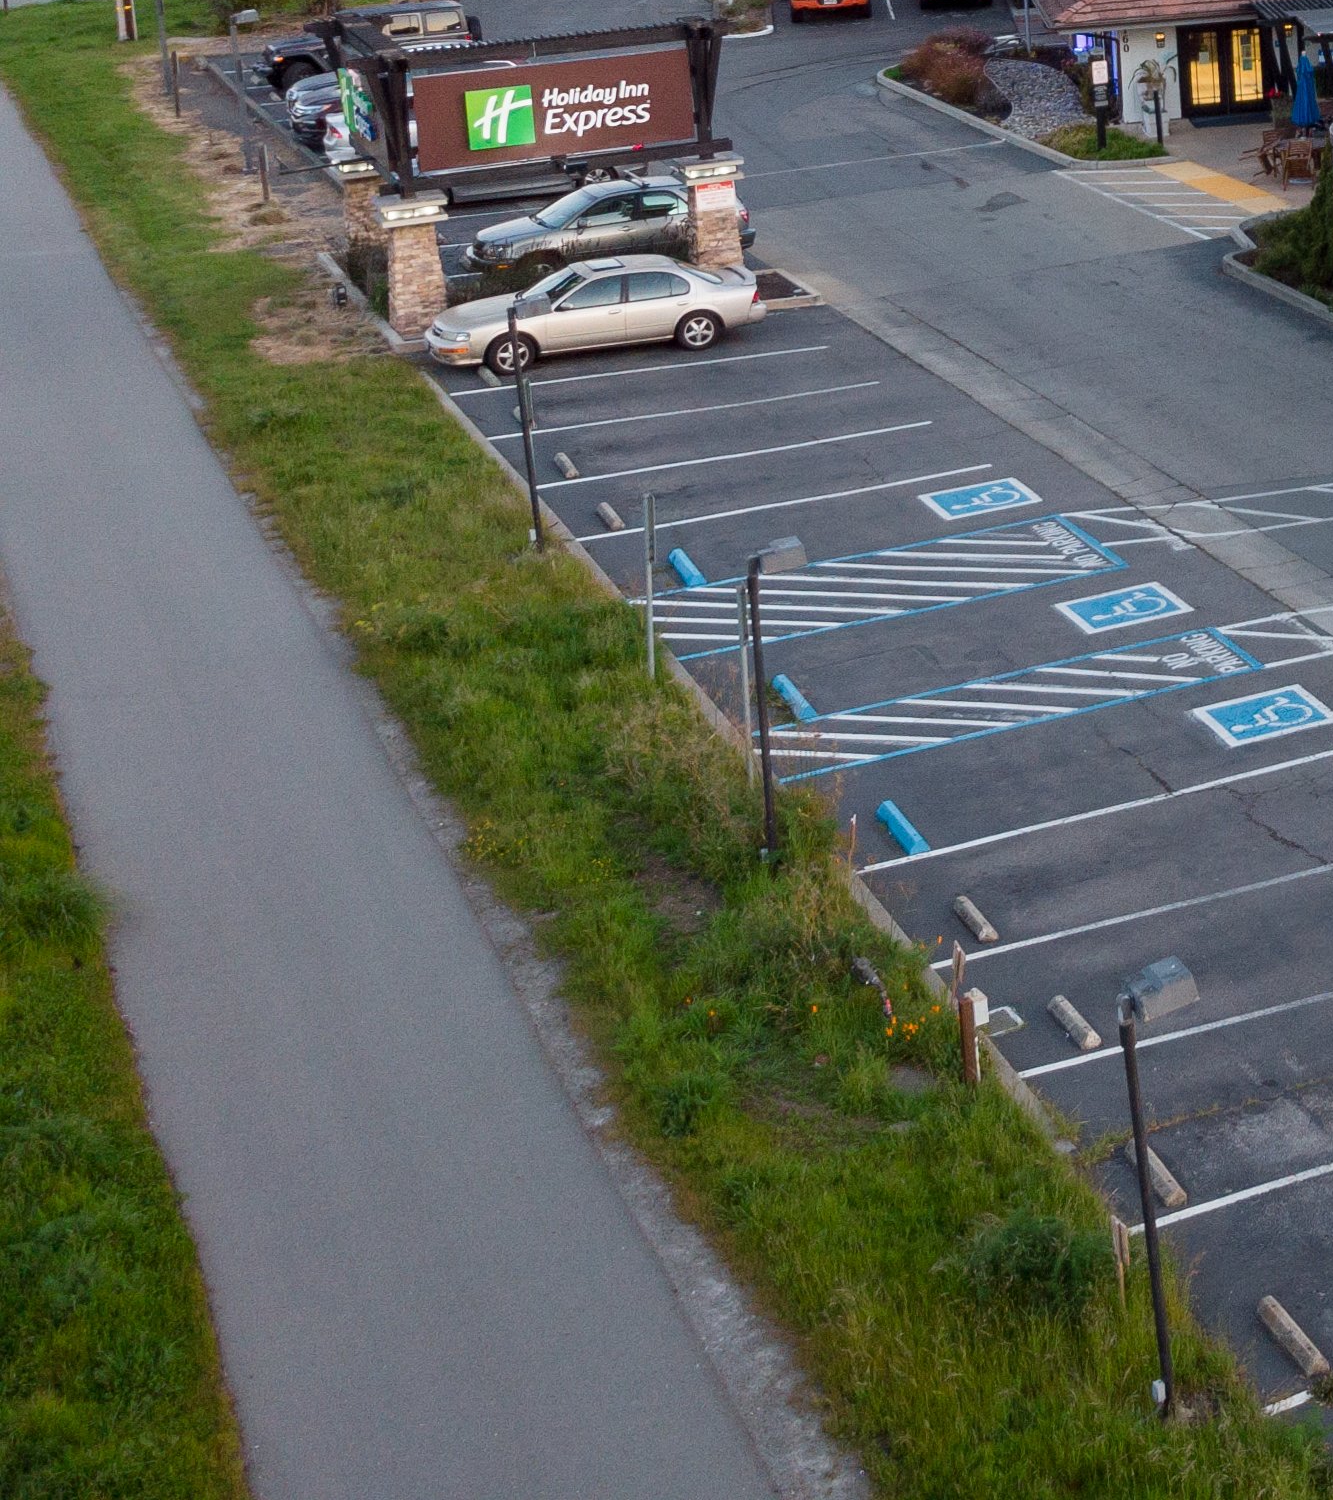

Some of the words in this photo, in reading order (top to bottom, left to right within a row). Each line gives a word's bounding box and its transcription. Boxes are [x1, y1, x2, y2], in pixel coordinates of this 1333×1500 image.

[542, 84, 617, 107] Holiday
[619, 80, 650, 99] Inn
[545, 103, 651, 137] Express
[1032, 521, 1091, 555] PARKING
[1074, 553, 1112, 569] NO
[1161, 652, 1199, 670] NO
[1181, 633, 1250, 673] PARKING
